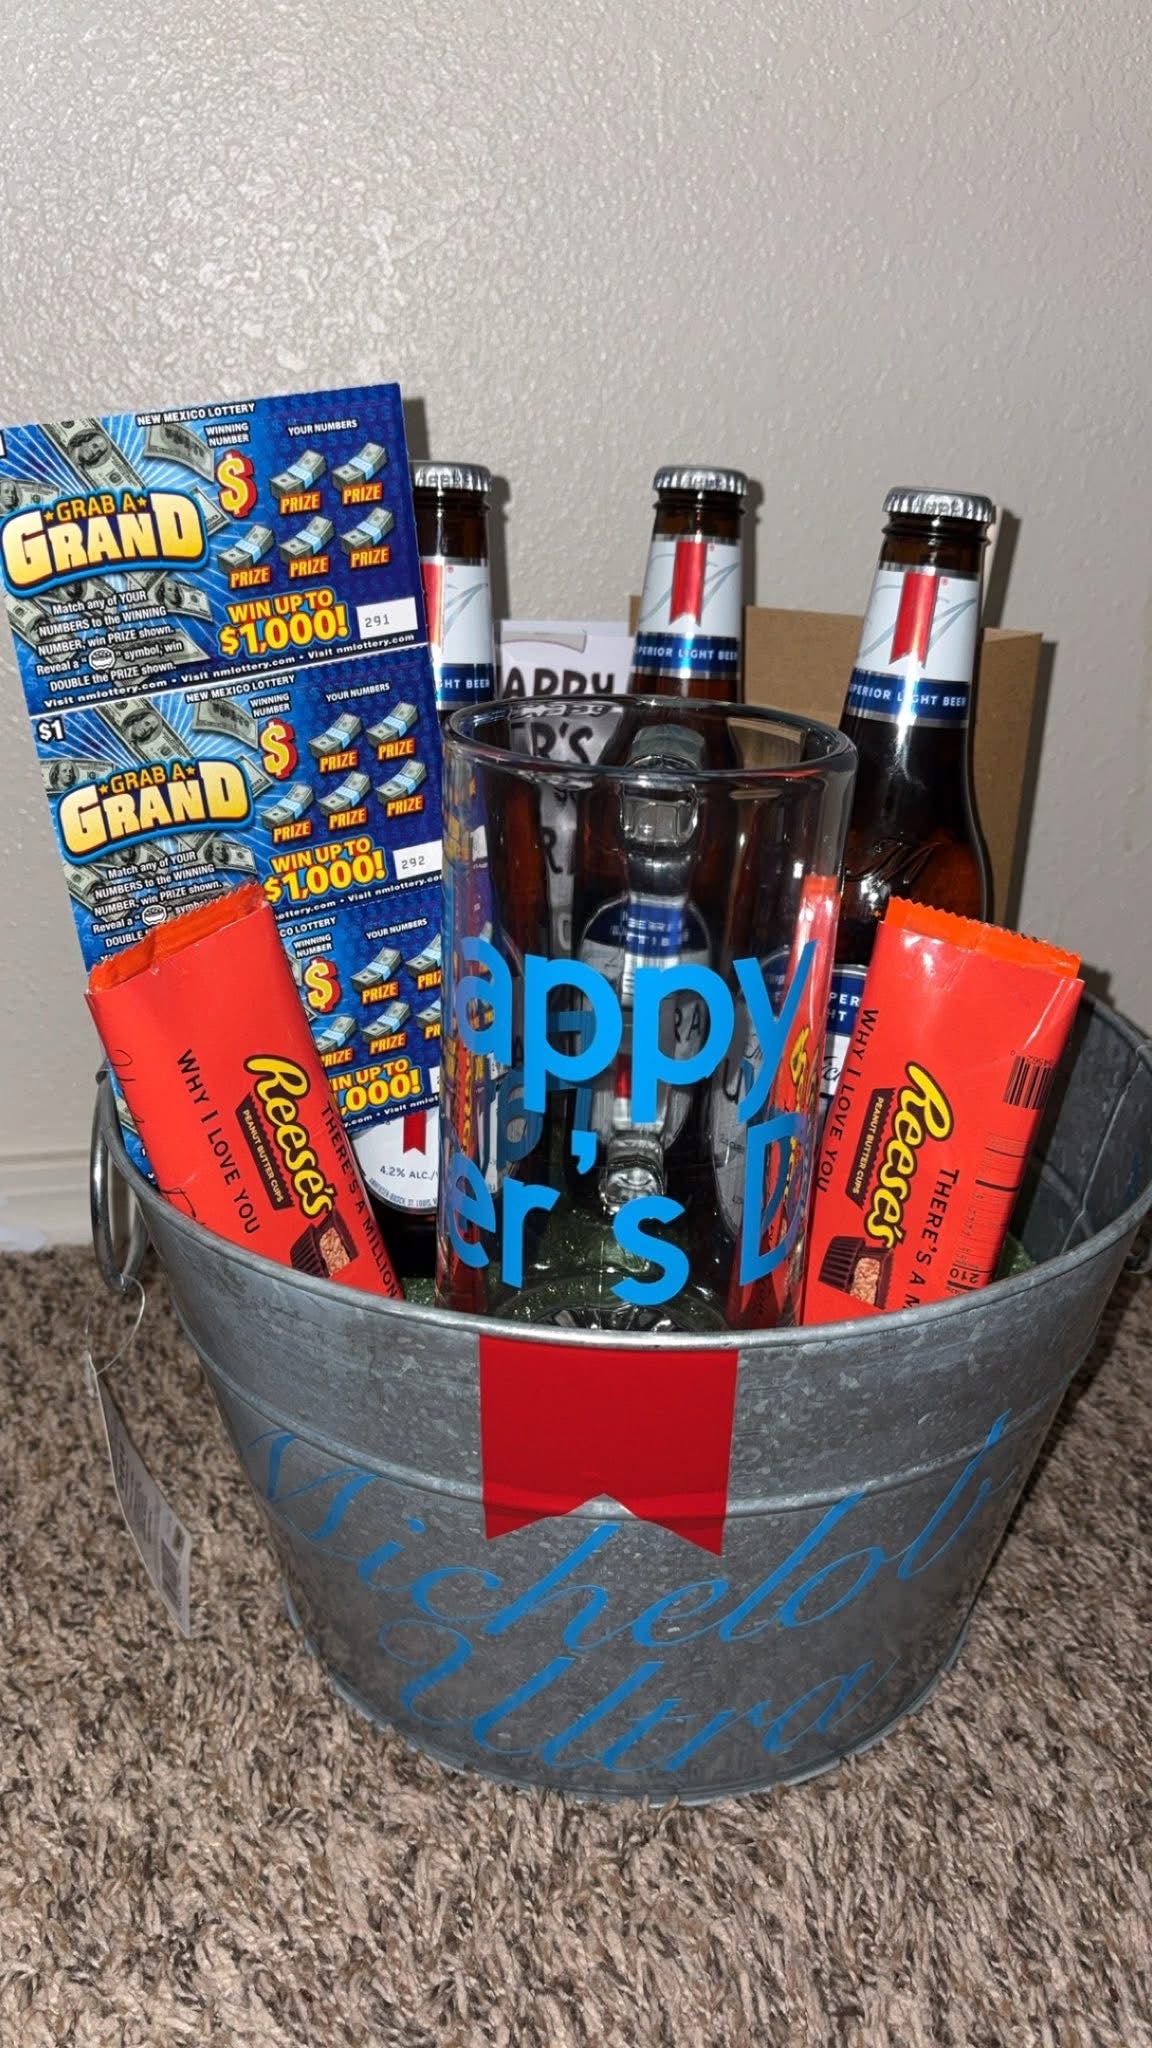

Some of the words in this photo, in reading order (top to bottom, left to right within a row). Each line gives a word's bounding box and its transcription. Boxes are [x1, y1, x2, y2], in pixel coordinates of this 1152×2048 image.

[136, 412, 161, 428] NEW
[163, 408, 206, 423] MEXICO
[207, 403, 256, 418] LOTTERY
[288, 425, 313, 437] YOUR
[313, 420, 358, 434] NUMBERS
[205, 422, 249, 437] WINNING
[208, 434, 249, 448] NUMBER
[56, 495, 116, 521] GRAB
[122, 493, 138, 512] A
[281, 495, 320, 514] PRIZE
[343, 484, 381, 504] PRIZE
[2, 493, 203, 587] GRAND
[290, 557, 329, 578] PRIZE
[351, 547, 390, 569] PRIZE
[231, 567, 270, 588] PRIZE
[52, 601, 86, 615] Match
[87, 599, 107, 612] any
[108, 595, 118, 608] of
[119, 590, 148, 606] YOUR
[227, 601, 272, 624] WIN
[274, 594, 303, 615] UP
[304, 588, 333, 610] TO
[38, 618, 90, 637] NUMBERS
[92, 616, 103, 627] to
[104, 612, 120, 626] the
[121, 605, 168, 623] WINNING
[219, 605, 349, 656] $1,000!
[364, 613, 390, 629] 291
[37, 640, 87, 659] NUMBER,
[88, 635, 106, 649] win
[107, 629, 138, 646] PRIZE
[139, 625, 175, 641] shown.
[36, 657, 71, 676] Reveal
[72, 660, 80, 669] a
[123, 646, 163, 663] symbol,
[164, 640, 184, 653] win
[44, 695, 74, 709] Visit
[77, 678, 168, 703] nmlottery.com
[181, 668, 210, 683] Visit
[213, 653, 296, 680] nmlottery.com
[307, 646, 334, 662] Visit
[337, 632, 416, 656] nmlottery.com
[49, 674, 91, 693] DOUBLE
[92, 669, 110, 683] the
[110, 664, 141, 681] PRIZE
[141, 659, 177, 675] shown.
[185, 691, 207, 704] NEW
[210, 685, 250, 700] MEXICO
[251, 675, 295, 692] LOTTERY
[250, 692, 290, 708] WINNING
[326, 690, 350, 703] YOUR
[350, 682, 391, 698] NUMBERS
[253, 704, 291, 718] NUMBER
[38, 719, 64, 742] $1
[320, 750, 358, 773] PRIZE
[378, 737, 416, 760] PRIZE
[110, 765, 166, 795] GRAB
[172, 762, 187, 782] A
[60, 760, 249, 854] GRAND
[329, 807, 368, 830] PRIZE
[387, 795, 424, 817] PRIZE
[273, 821, 312, 844] PRIZE
[107, 864, 138, 880] Match
[139, 860, 158, 874] any
[159, 857, 169, 868] of
[170, 849, 197, 866] YOUR
[271, 852, 312, 875] WIN
[314, 844, 344, 866] UP
[345, 837, 372, 859] TO
[401, 855, 425, 870] 292
[94, 879, 143, 900] NUMBERS
[144, 876, 155, 888] to
[156, 873, 171, 887] the
[172, 863, 215, 882] WINNING
[264, 849, 386, 903] $1,000!
[93, 899, 139, 918] NUMBER,
[140, 896, 158, 907] win
[158, 886, 187, 904] PRIZE
[188, 881, 222, 897] shown.
[346, 890, 373, 904] Visit
[92, 918, 125, 935] Reveal
[126, 916, 133, 927] a
[295, 916, 336, 934] LOTTERY
[367, 929, 389, 941] YOUR
[388, 919, 428, 936] NUMBERS
[105, 929, 144, 948] DOUBLE
[293, 933, 331, 949] WINNING
[296, 944, 333, 959] NUMBER
[362, 981, 398, 1004] PRIZE
[370, 1035, 407, 1056] PRIZE
[852, 1009, 879, 1061] WHY
[177, 1048, 210, 1104] WHY
[328, 1074, 352, 1091] IN
[355, 1066, 382, 1084] UP
[383, 1058, 409, 1077] TO
[847, 1068, 861, 1078] I
[334, 1069, 421, 1117] ,000!
[201, 1109, 219, 1123] I
[384, 1102, 407, 1116] Visit
[829, 1084, 855, 1141] LOVE
[870, 1096, 884, 1135] PEANUT
[245, 1056, 334, 1217] Reese's
[321, 1100, 359, 1196] THERE'S
[207, 1127, 241, 1186] LOVE
[243, 1109, 263, 1147] PEANUT
[256, 1144, 275, 1180] BUTTER
[270, 1178, 285, 1203] CUPS
[859, 1134, 874, 1170] BUTTER
[866, 1063, 953, 1250] Reese's
[380, 1164, 406, 1179] 4.2%
[817, 1149, 838, 1193] YOU
[852, 1168, 865, 1195] CUPS
[233, 1188, 261, 1234] YOU
[355, 1200, 369, 1215] A
[914, 1169, 960, 1265] THERE'S
[361, 1218, 403, 1299] MILLION
[909, 1271, 926, 1285] A
[246, 1408, 1018, 1653] Michelob
[377, 1618, 900, 1776] Ultra
